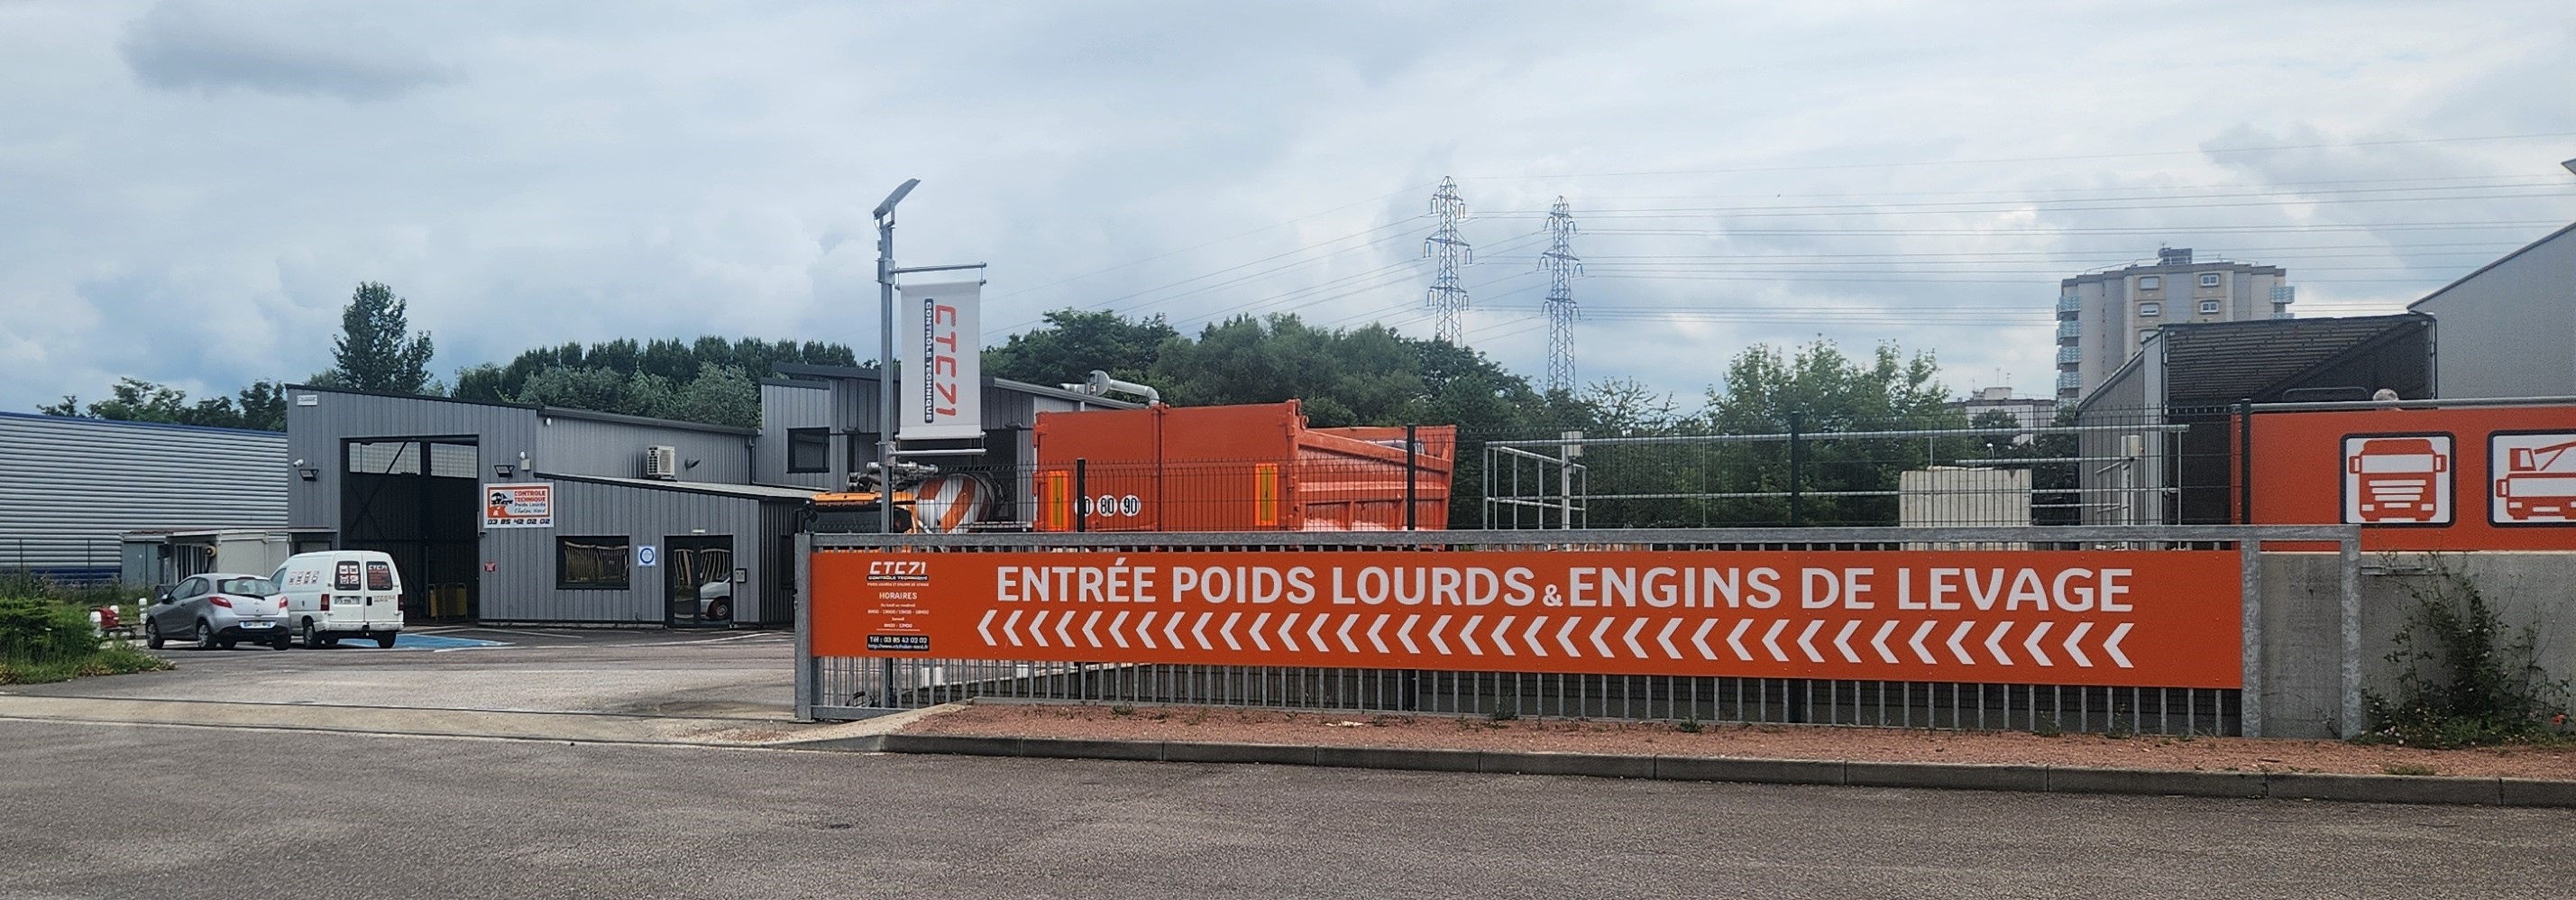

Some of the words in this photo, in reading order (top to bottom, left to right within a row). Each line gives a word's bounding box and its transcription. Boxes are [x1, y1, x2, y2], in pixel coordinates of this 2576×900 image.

[935, 305, 957, 417] CTC71
[1100, 497, 1114, 515] 80
[1123, 497, 1138, 515] 90
[870, 561, 926, 574] CTC71
[997, 556, 1156, 602] ENTRÉE
[1172, 565, 1316, 605] POIDS
[1333, 566, 1536, 607] LOURDS
[1542, 583, 1564, 607] &
[1570, 566, 1782, 610] ENGINS
[1801, 567, 1875, 611] DE
[1898, 567, 2133, 612] LEVAGE
[879, 592, 918, 600] HORAIRES
